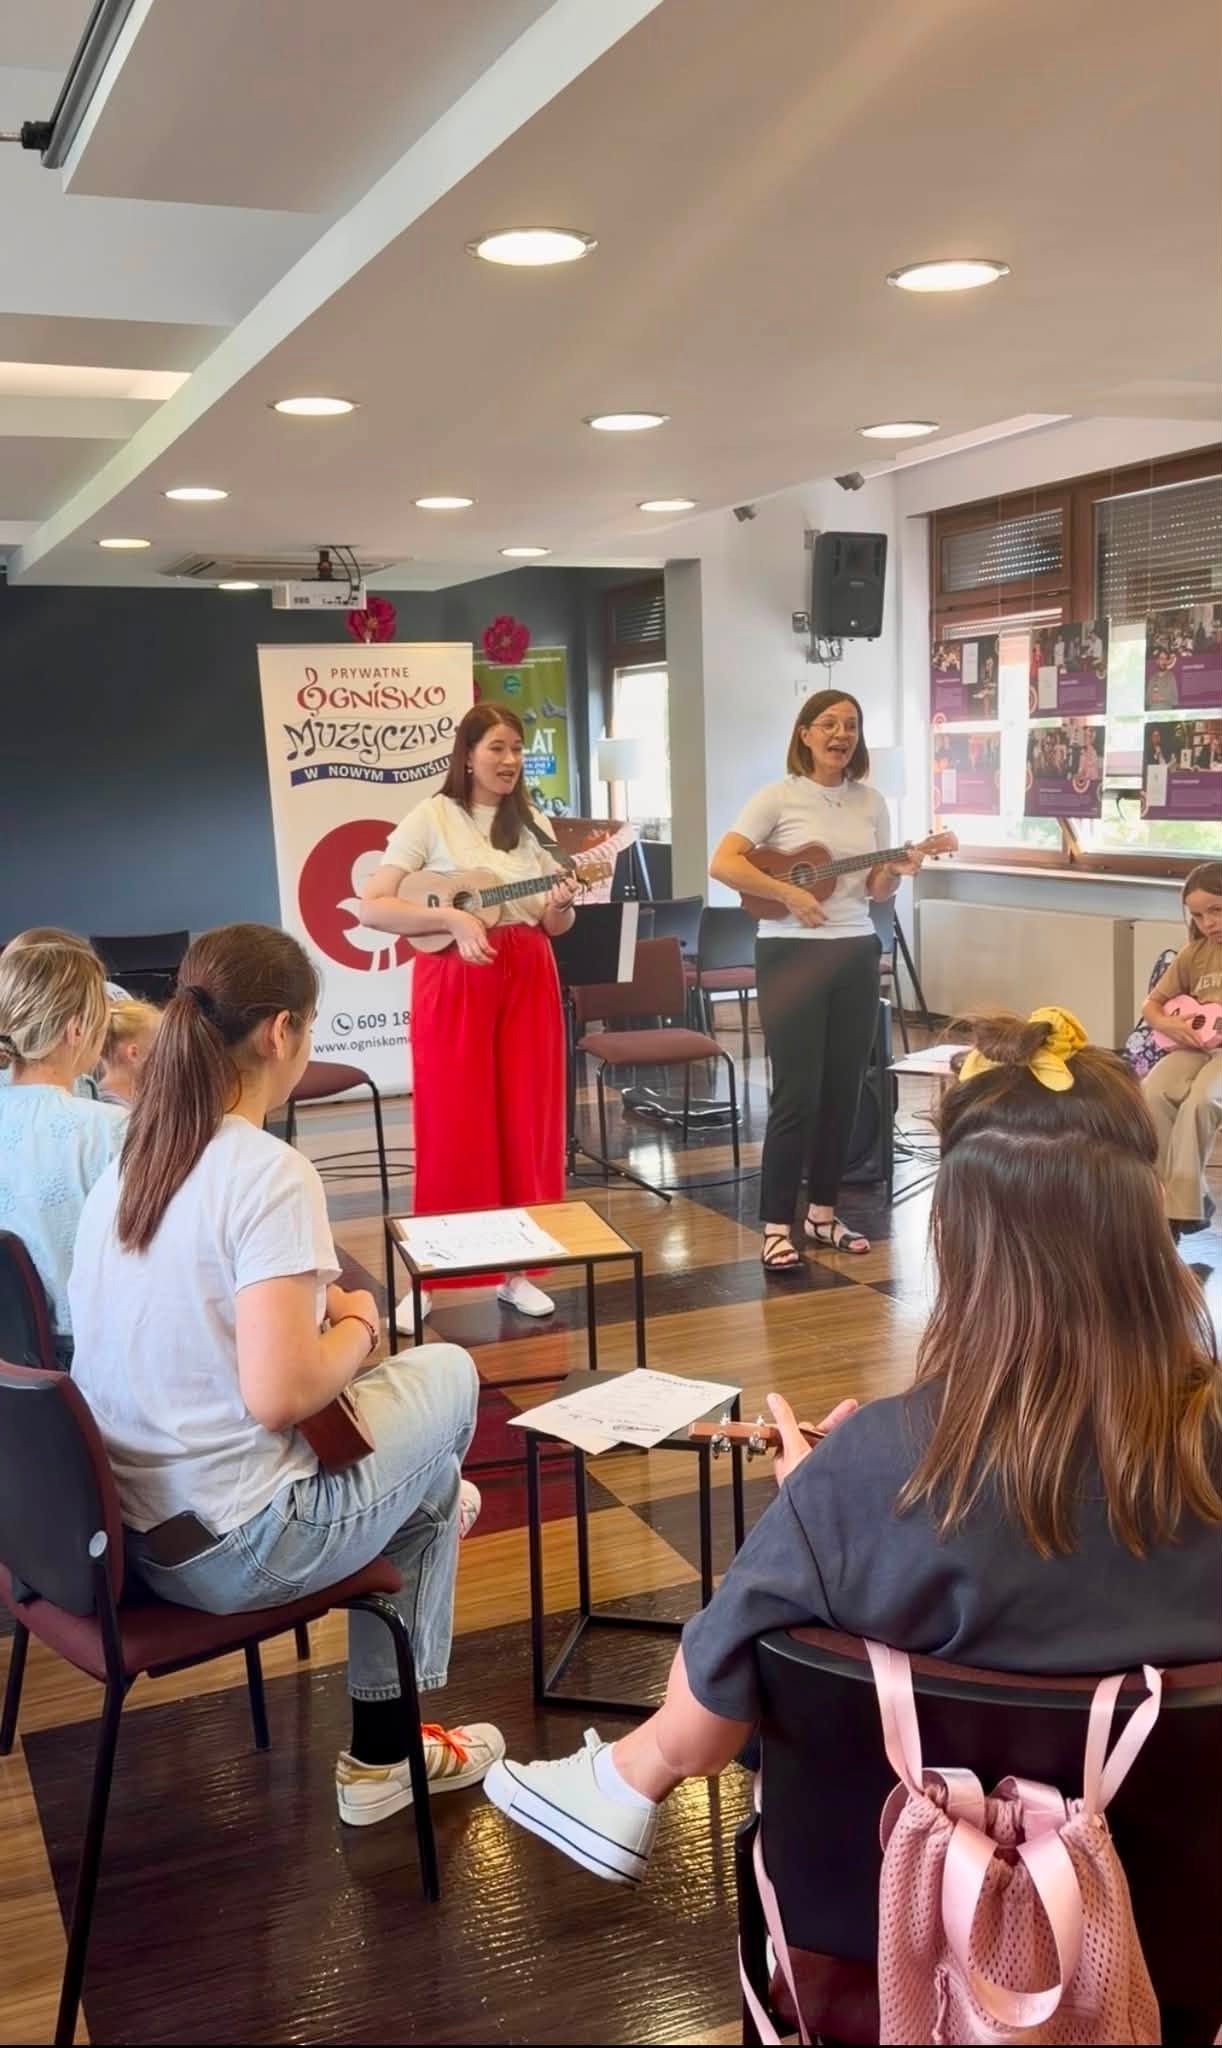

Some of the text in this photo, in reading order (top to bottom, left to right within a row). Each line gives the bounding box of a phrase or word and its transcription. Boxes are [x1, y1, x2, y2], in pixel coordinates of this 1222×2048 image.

[330, 667, 410, 679] PRYWATNE
[521, 728, 556, 754] AT
[303, 757, 450, 783] W NOWYM TOMYŚLU
[357, 1013, 387, 1029] 609
[314, 1035, 412, 1054] www.ogniskom
